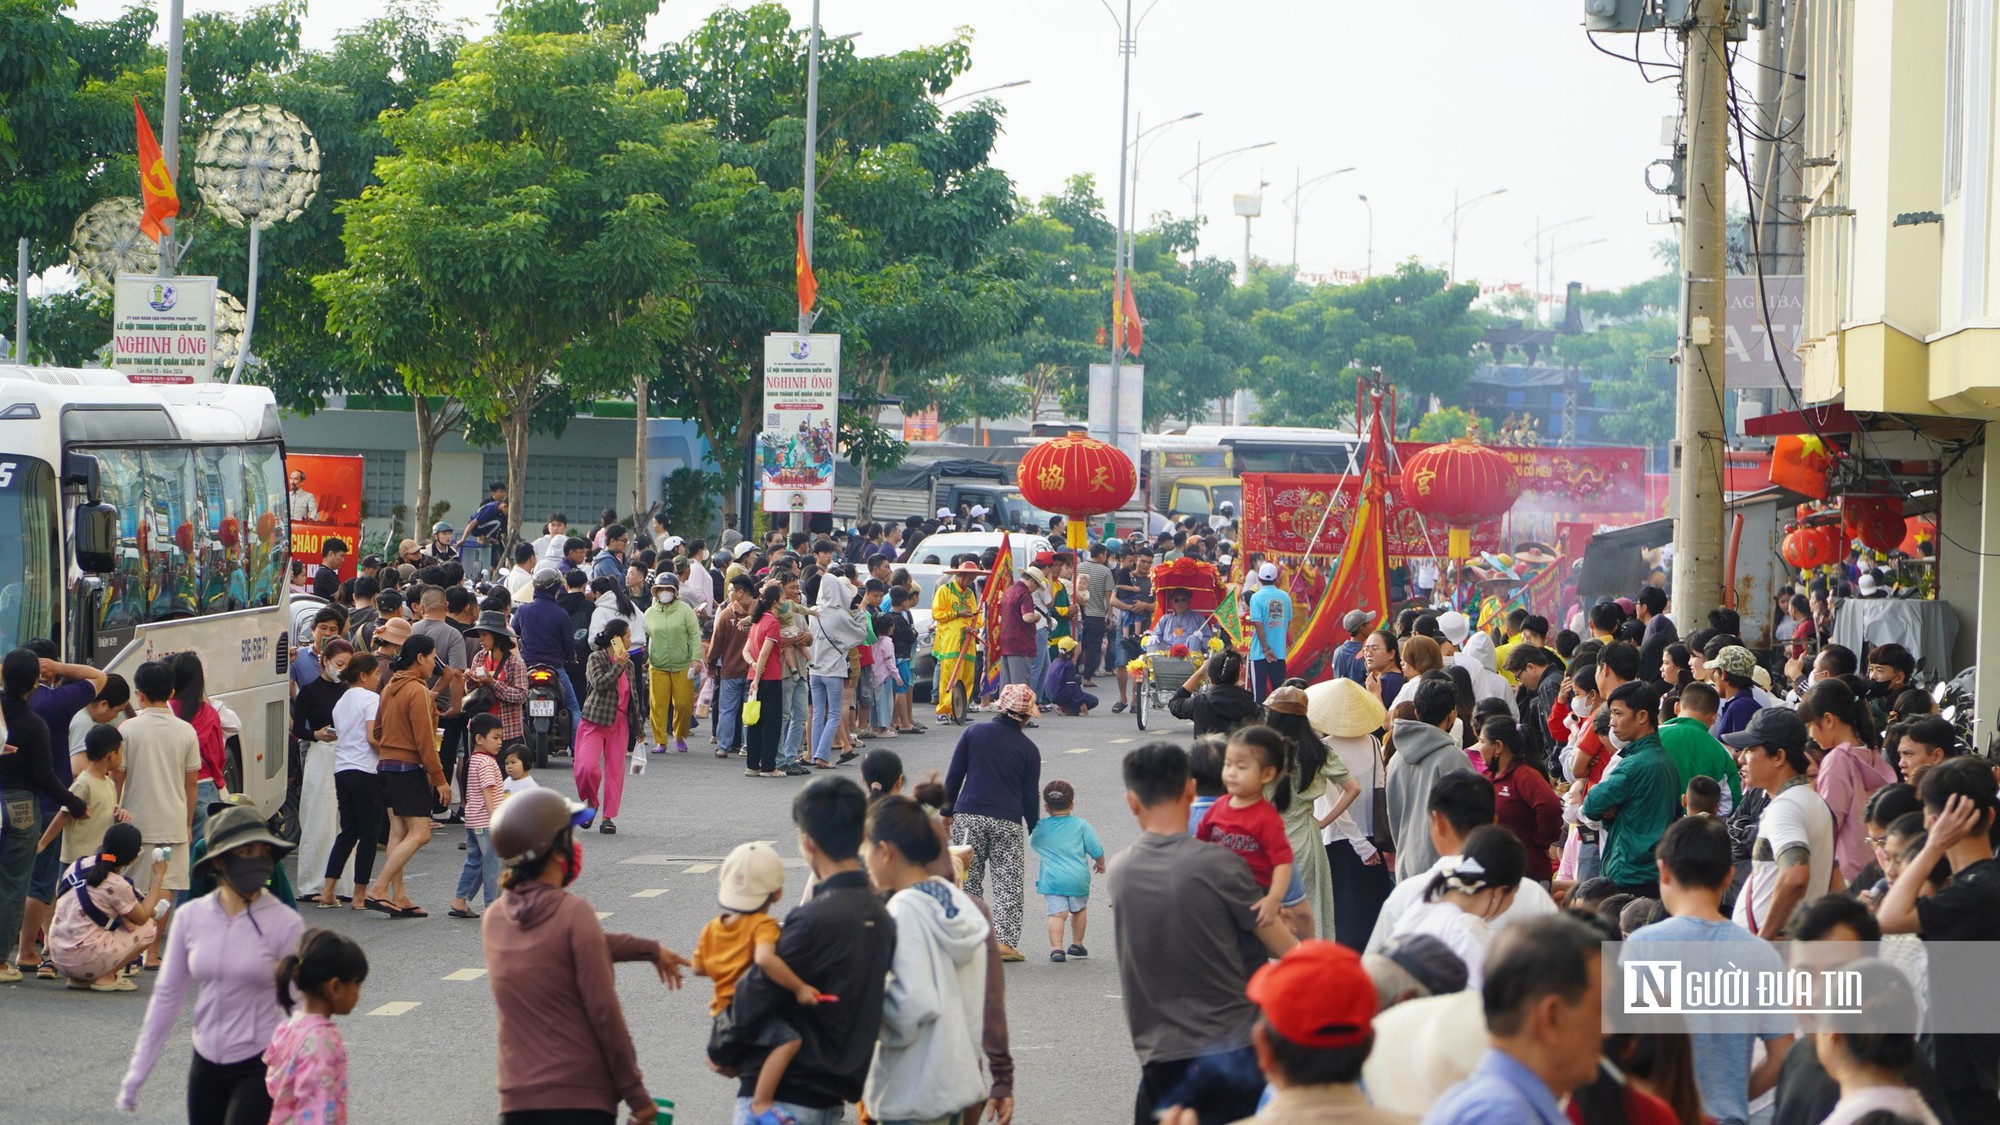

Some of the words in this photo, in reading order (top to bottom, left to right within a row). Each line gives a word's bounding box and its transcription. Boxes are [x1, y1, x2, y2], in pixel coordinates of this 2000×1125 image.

[125, 322, 134, 331] HỘI
[155, 323, 178, 331] NGUYÊN
[116, 336, 171, 353] NGHINH
[177, 334, 206, 354] ÔNG
[133, 357, 152, 365] THÁNH
[163, 358, 179, 367] QUÂN
[180, 357, 196, 366] XUẤT
[766, 376, 807, 389] NGHINH
[811, 375, 832, 389] ÔNG
[1037, 464, 1066, 491] 協
[1088, 466, 1116, 492] 天
[291, 531, 318, 553] CHÀO
